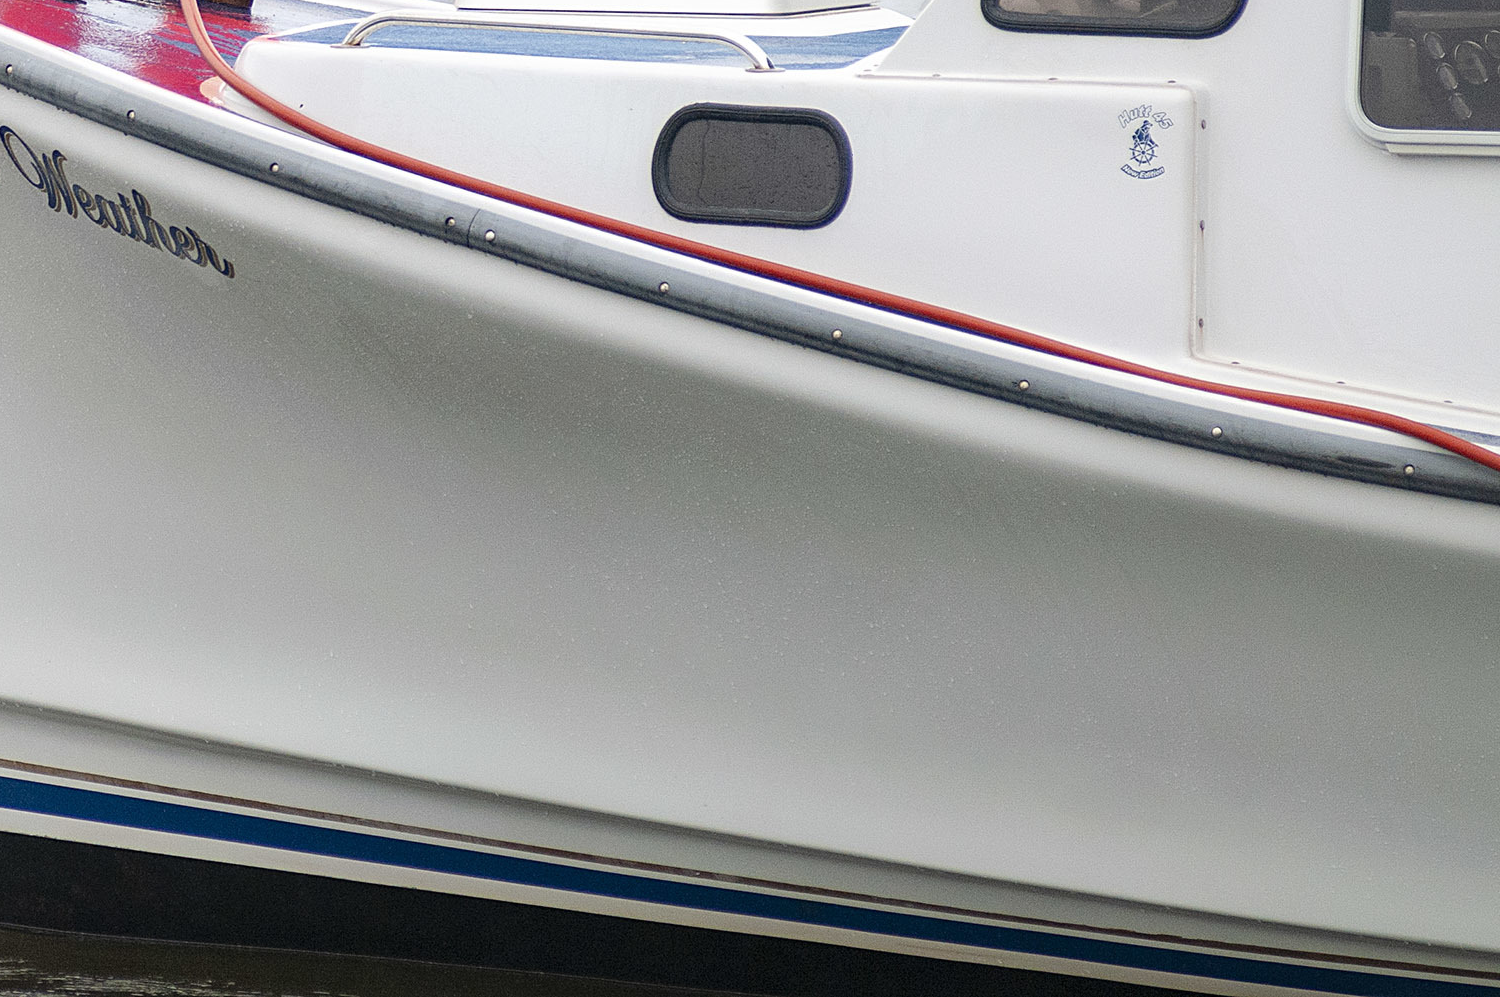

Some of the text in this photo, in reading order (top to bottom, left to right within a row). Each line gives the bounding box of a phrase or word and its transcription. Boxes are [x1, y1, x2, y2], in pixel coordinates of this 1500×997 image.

[1152, 112, 1174, 129] 45
[1121, 164, 1165, 179] New Edition
[0, 125, 235, 278] Weather
